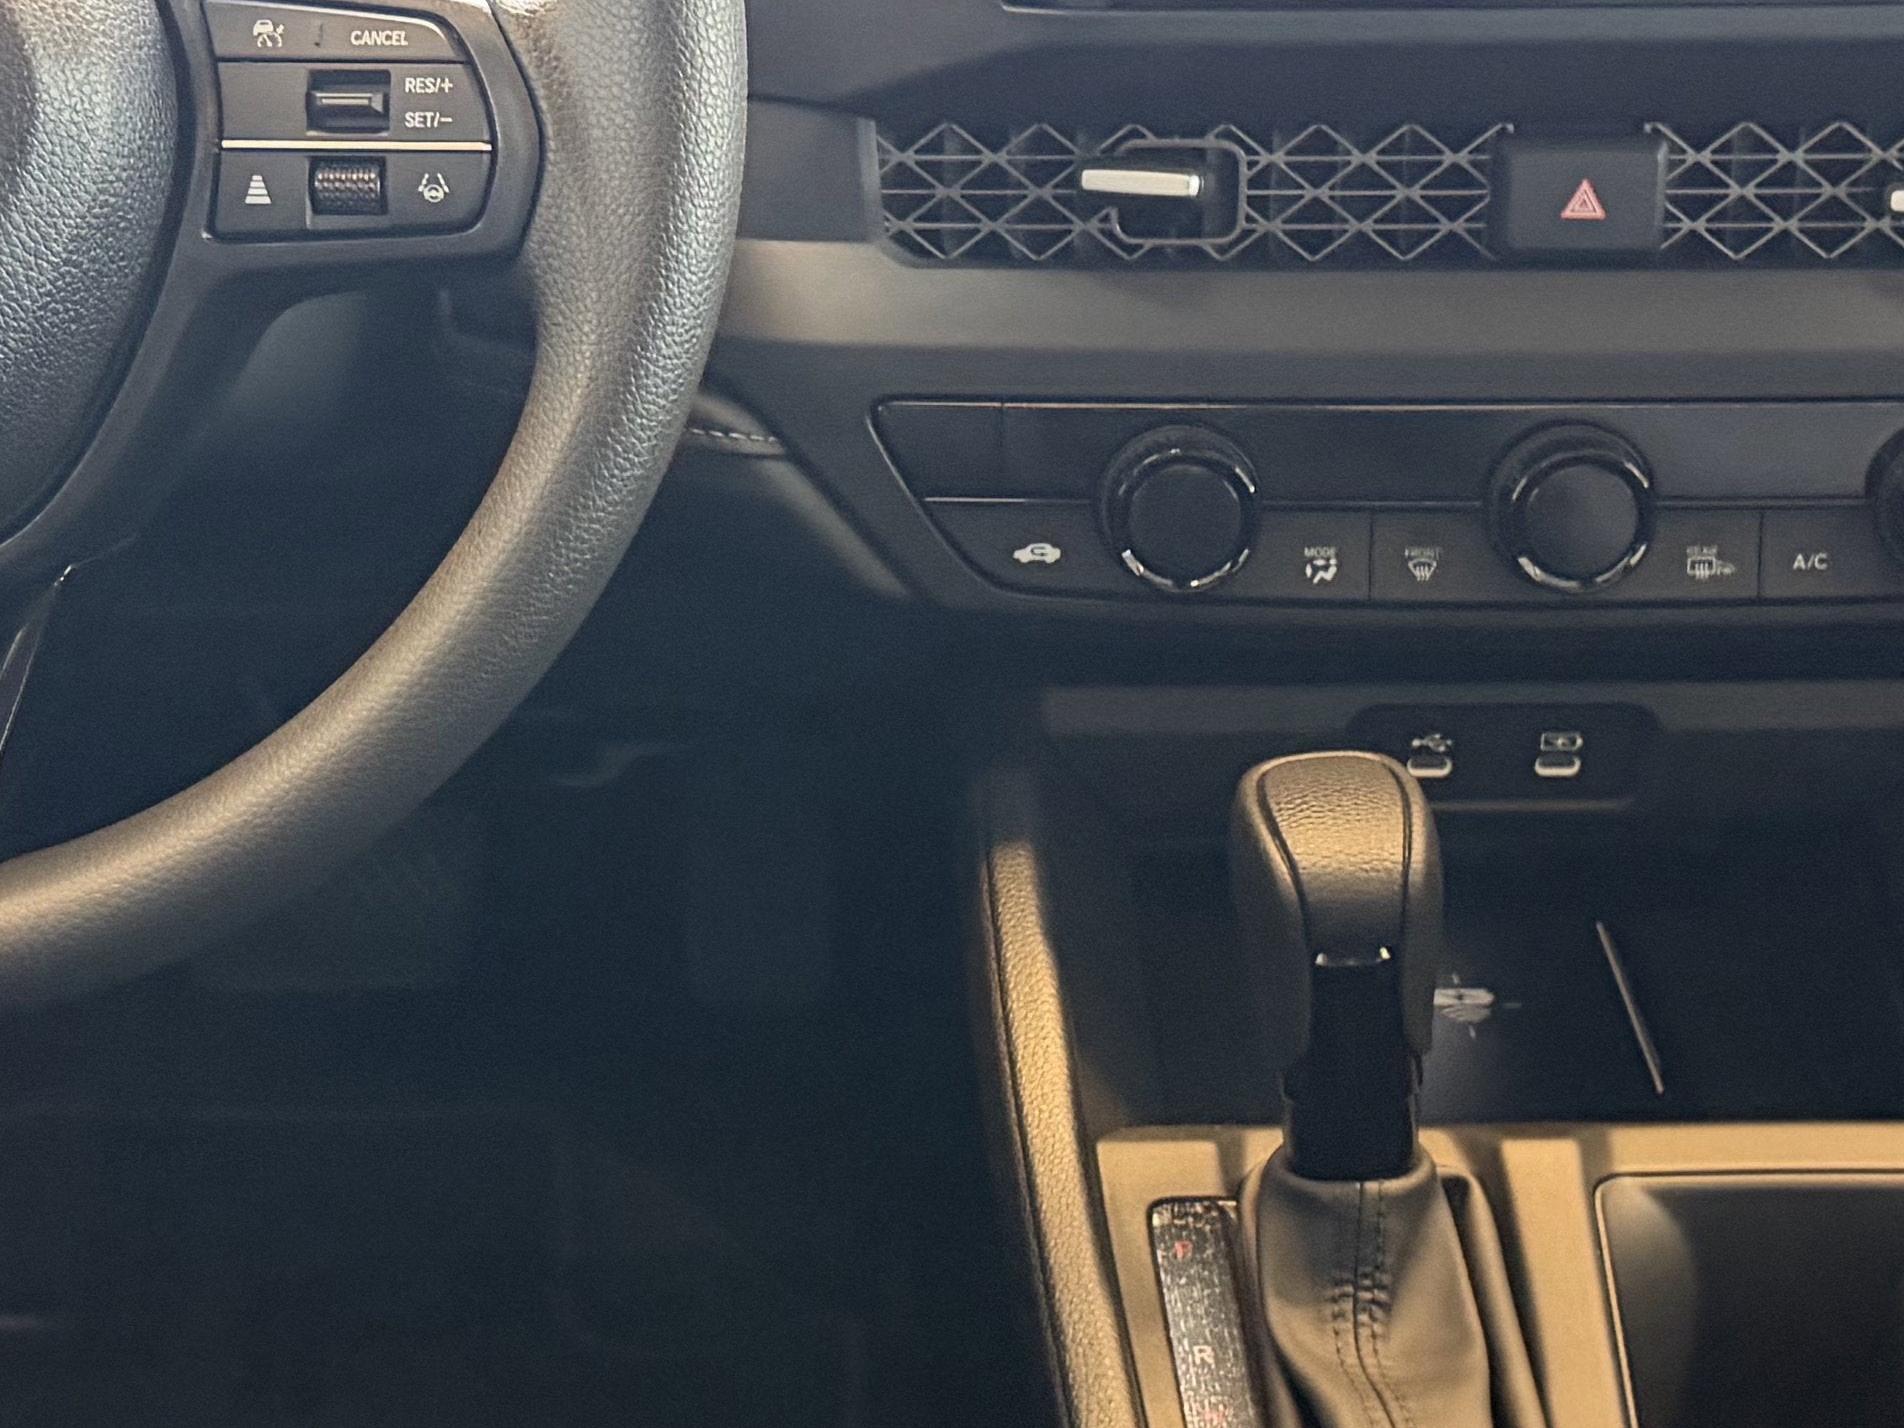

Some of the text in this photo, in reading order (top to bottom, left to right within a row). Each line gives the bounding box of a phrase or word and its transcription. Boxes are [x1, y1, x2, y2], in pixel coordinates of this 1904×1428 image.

[350, 30, 409, 46] CANCEL
[404, 77, 454, 93] RES/+
[404, 111, 453, 128] SET/-
[1304, 546, 1337, 558] MODE
[1793, 552, 1828, 571] A/C
